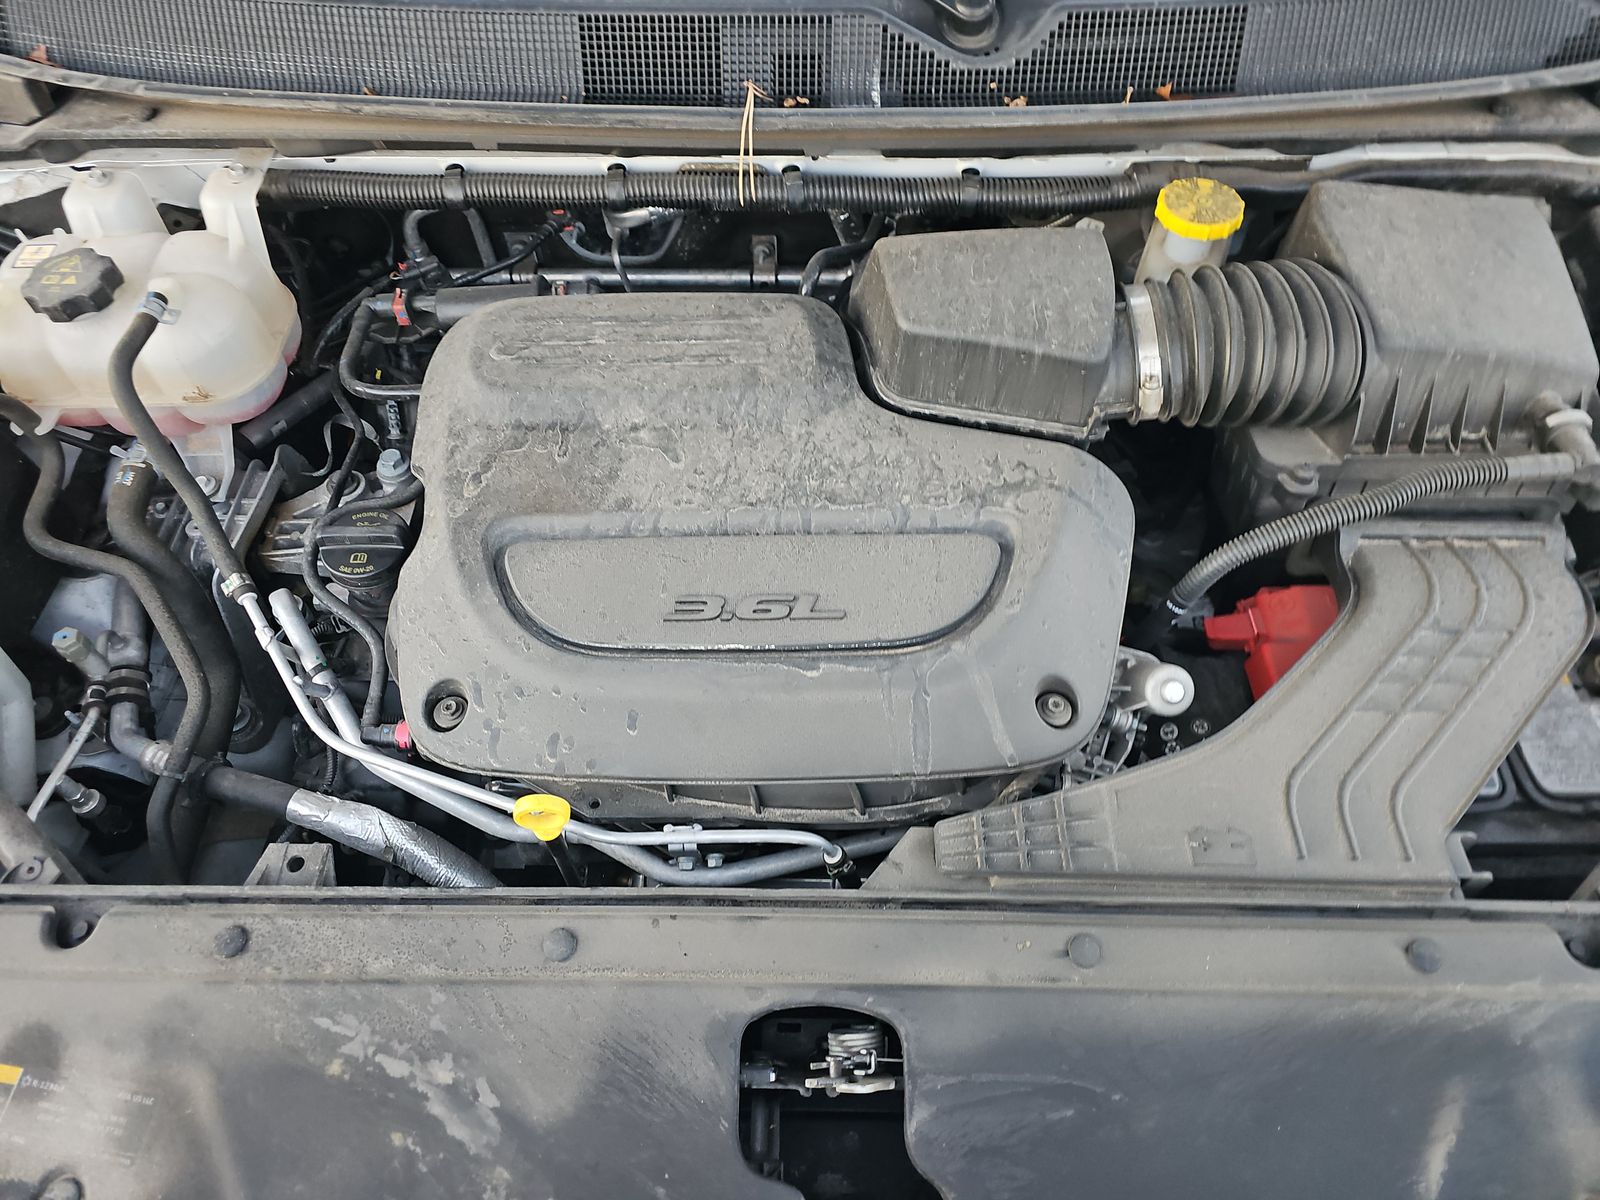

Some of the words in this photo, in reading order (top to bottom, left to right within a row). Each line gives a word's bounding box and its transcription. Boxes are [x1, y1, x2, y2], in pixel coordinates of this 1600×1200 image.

[352, 511, 379, 520] ENGINE
[339, 565, 352, 573] SAE
[353, 565, 374, 573] 0W-20
[663, 594, 847, 622] 3.6L
